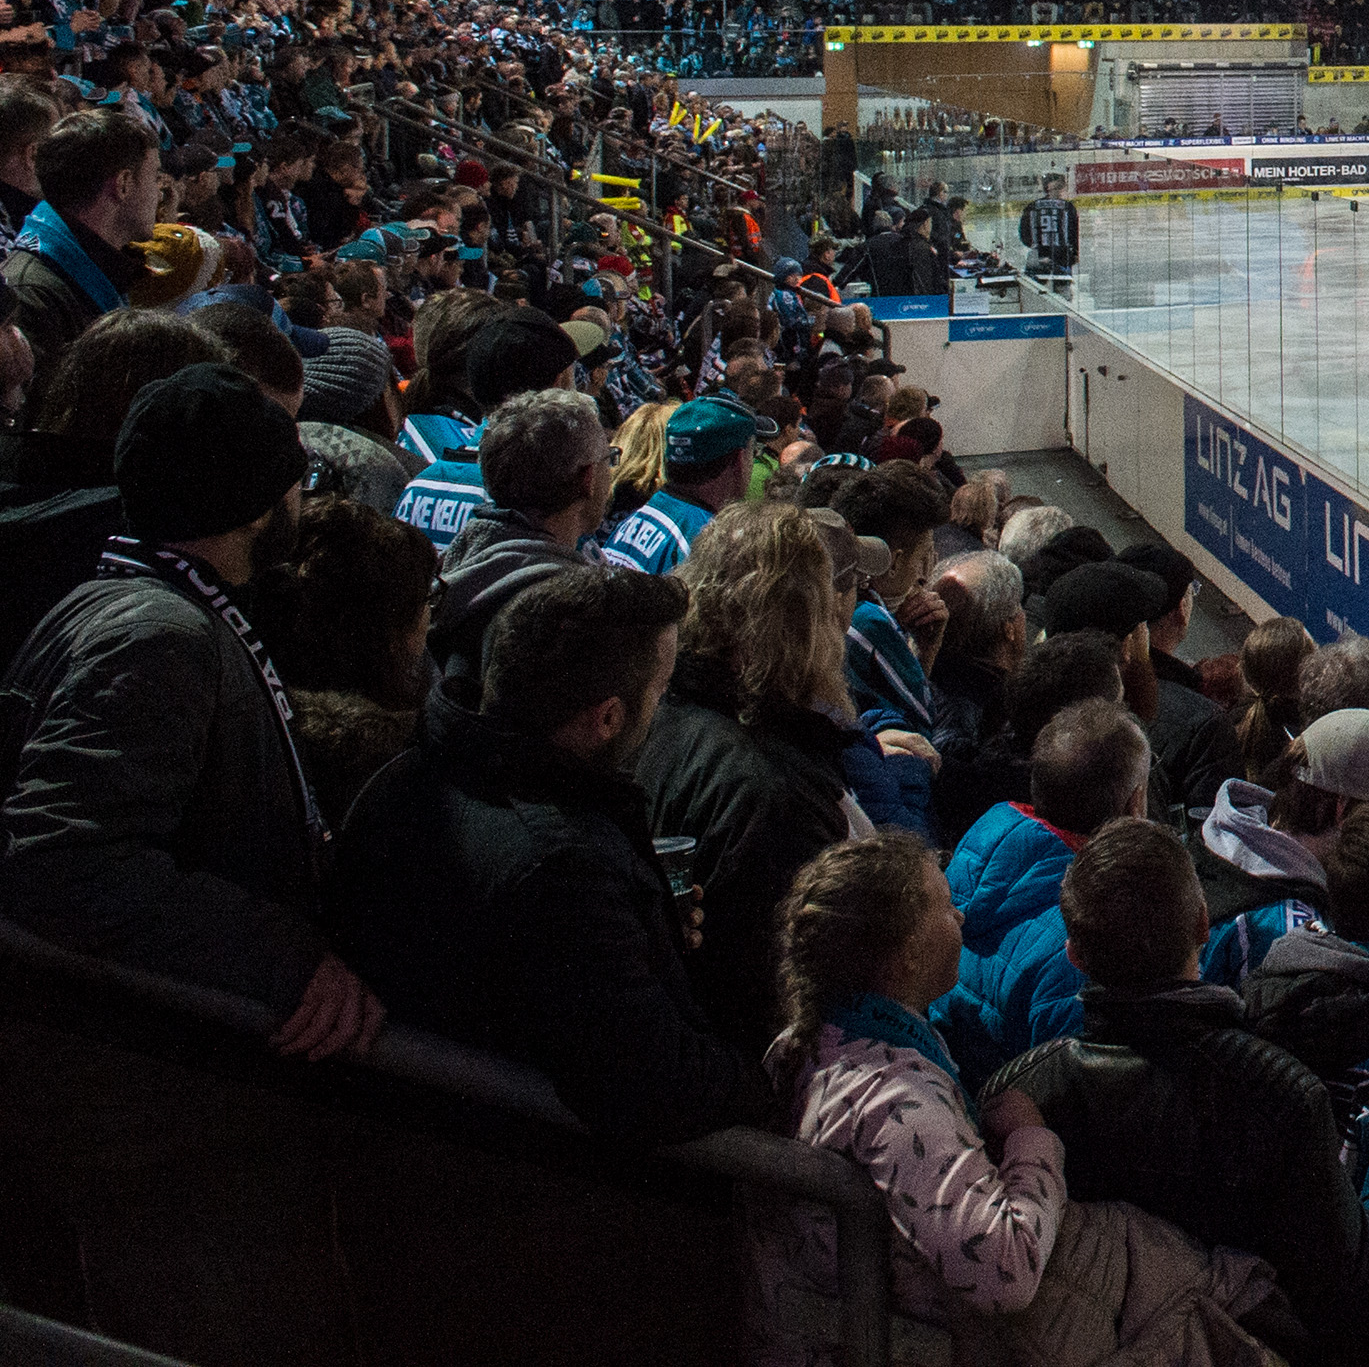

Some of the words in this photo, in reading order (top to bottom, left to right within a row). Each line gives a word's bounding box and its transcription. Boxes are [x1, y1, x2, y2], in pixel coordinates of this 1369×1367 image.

[1253, 166, 1283, 178] MEIN
[1288, 164, 1367, 177] HOLTER-BAD
[1196, 415, 1248, 501] LINZ
[1253, 455, 1291, 532] AG
[411, 495, 433, 530] KE
